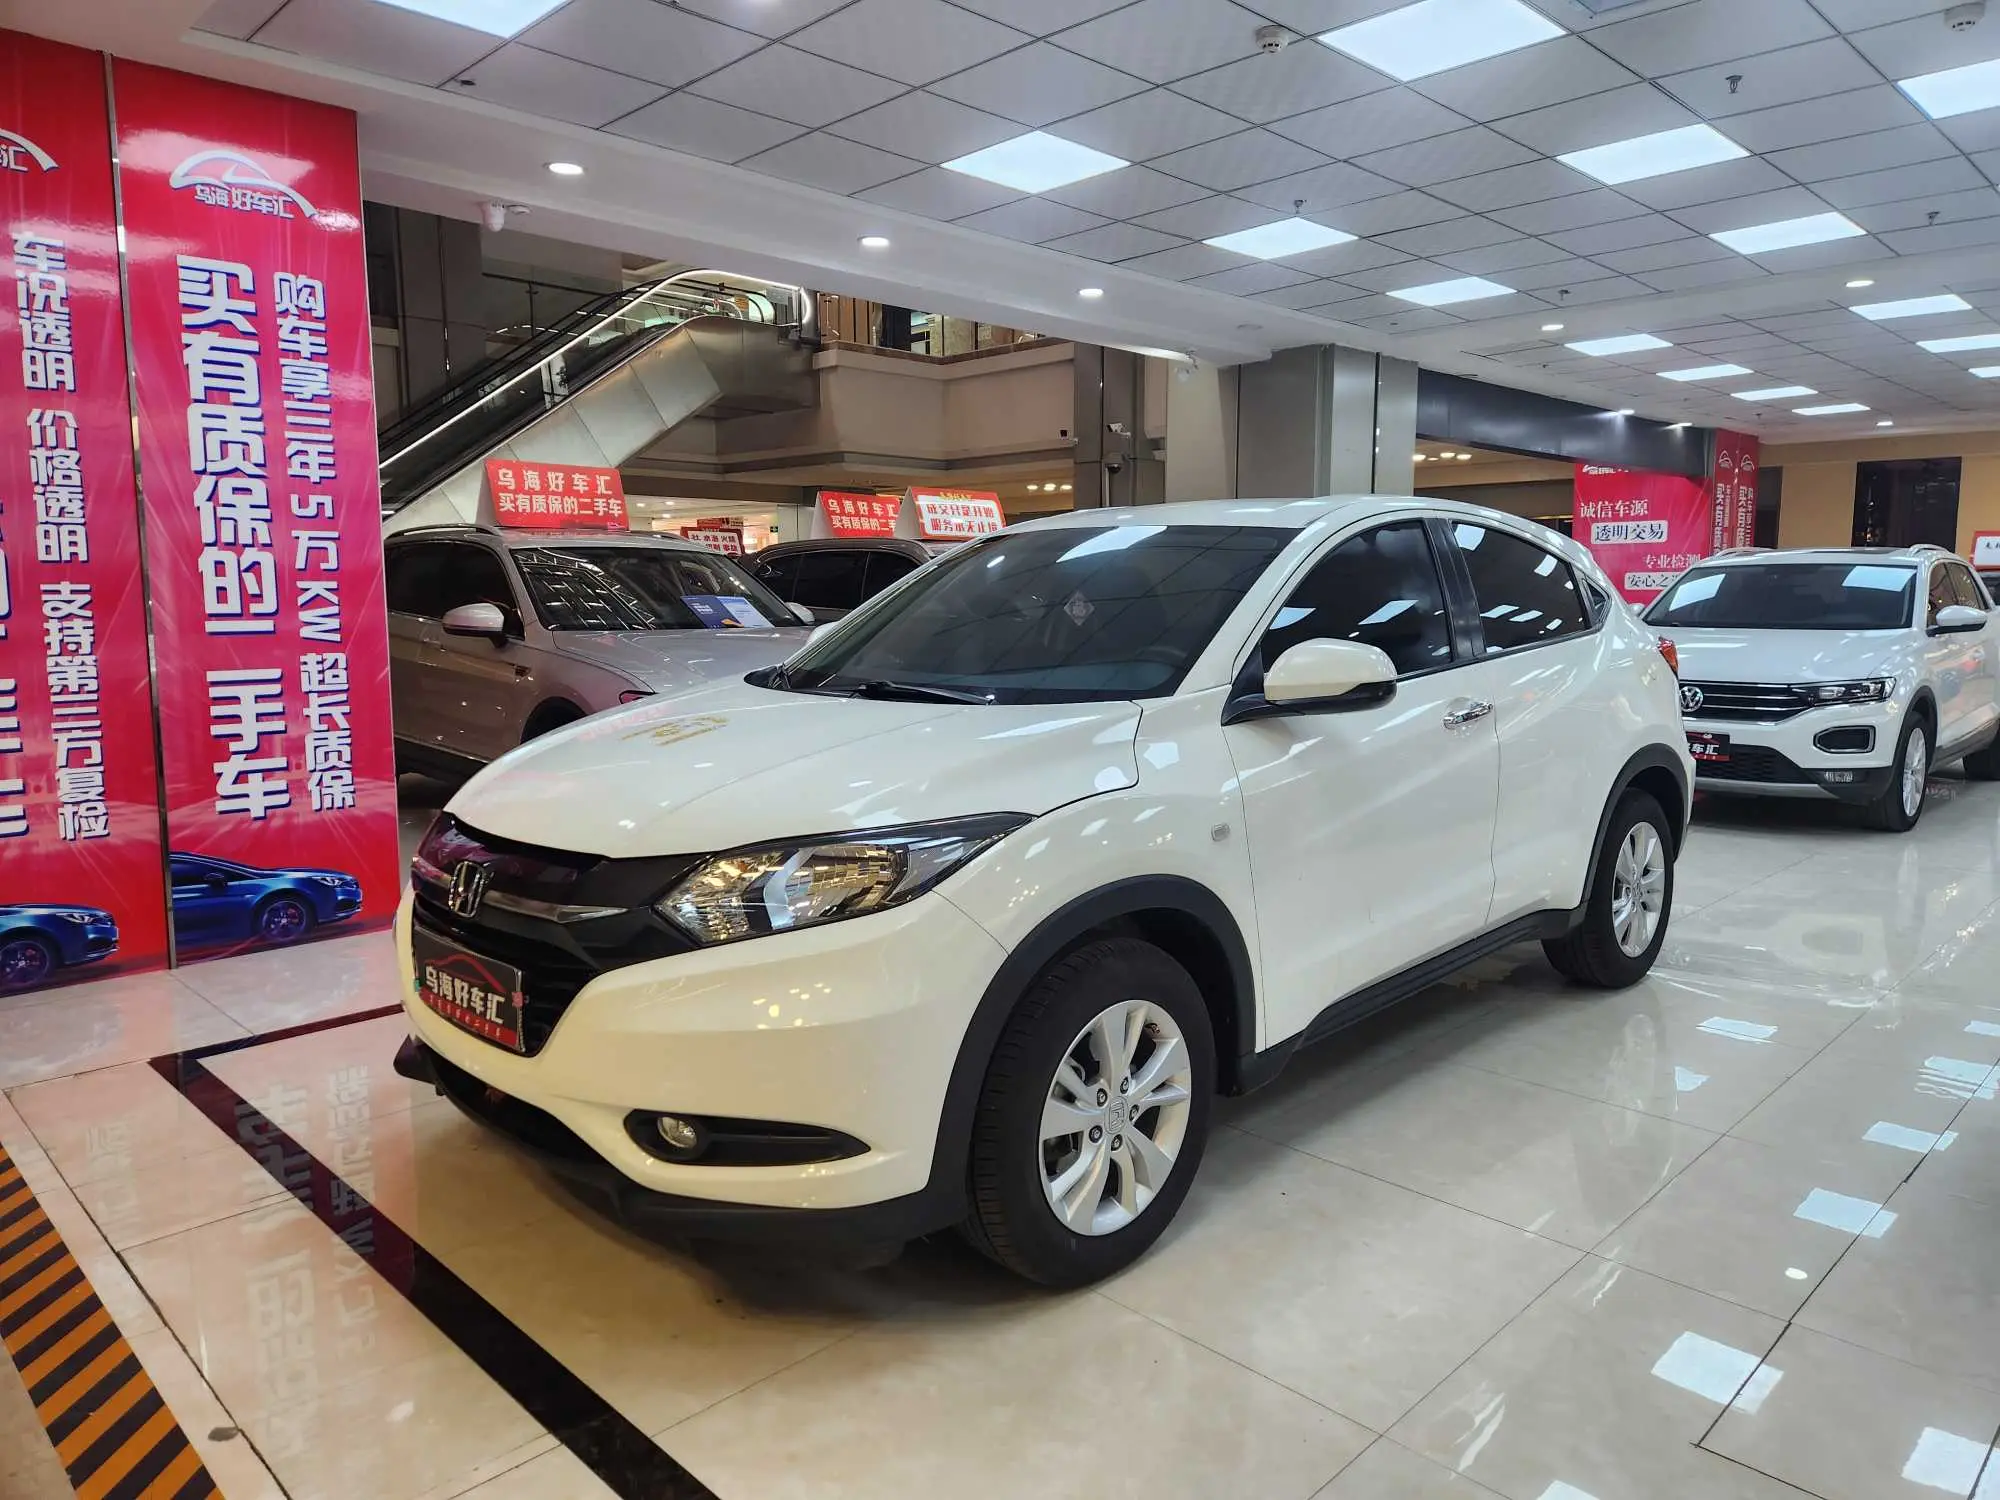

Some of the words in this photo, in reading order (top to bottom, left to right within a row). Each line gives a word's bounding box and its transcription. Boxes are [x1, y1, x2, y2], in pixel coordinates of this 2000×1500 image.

[0, 143, 29, 173] 汇
[194, 184, 295, 219] 乌海好车汇
[12, 231, 77, 393] 车况透明
[26, 407, 89, 562] 价格透明
[497, 468, 613, 495] 乌海好车汇
[498, 493, 622, 517] 买有质保的二手车
[1580, 499, 1648, 518] 诚信车源
[176, 254, 291, 820] 买有质保的二手车
[1594, 523, 1664, 541] 透明交易
[1628, 573, 1679, 588] 安心之
[39, 580, 111, 841] 支持第三方复检
[1687, 743, 1720, 755] 车汇
[425, 966, 506, 1024] 乌海好车汇
